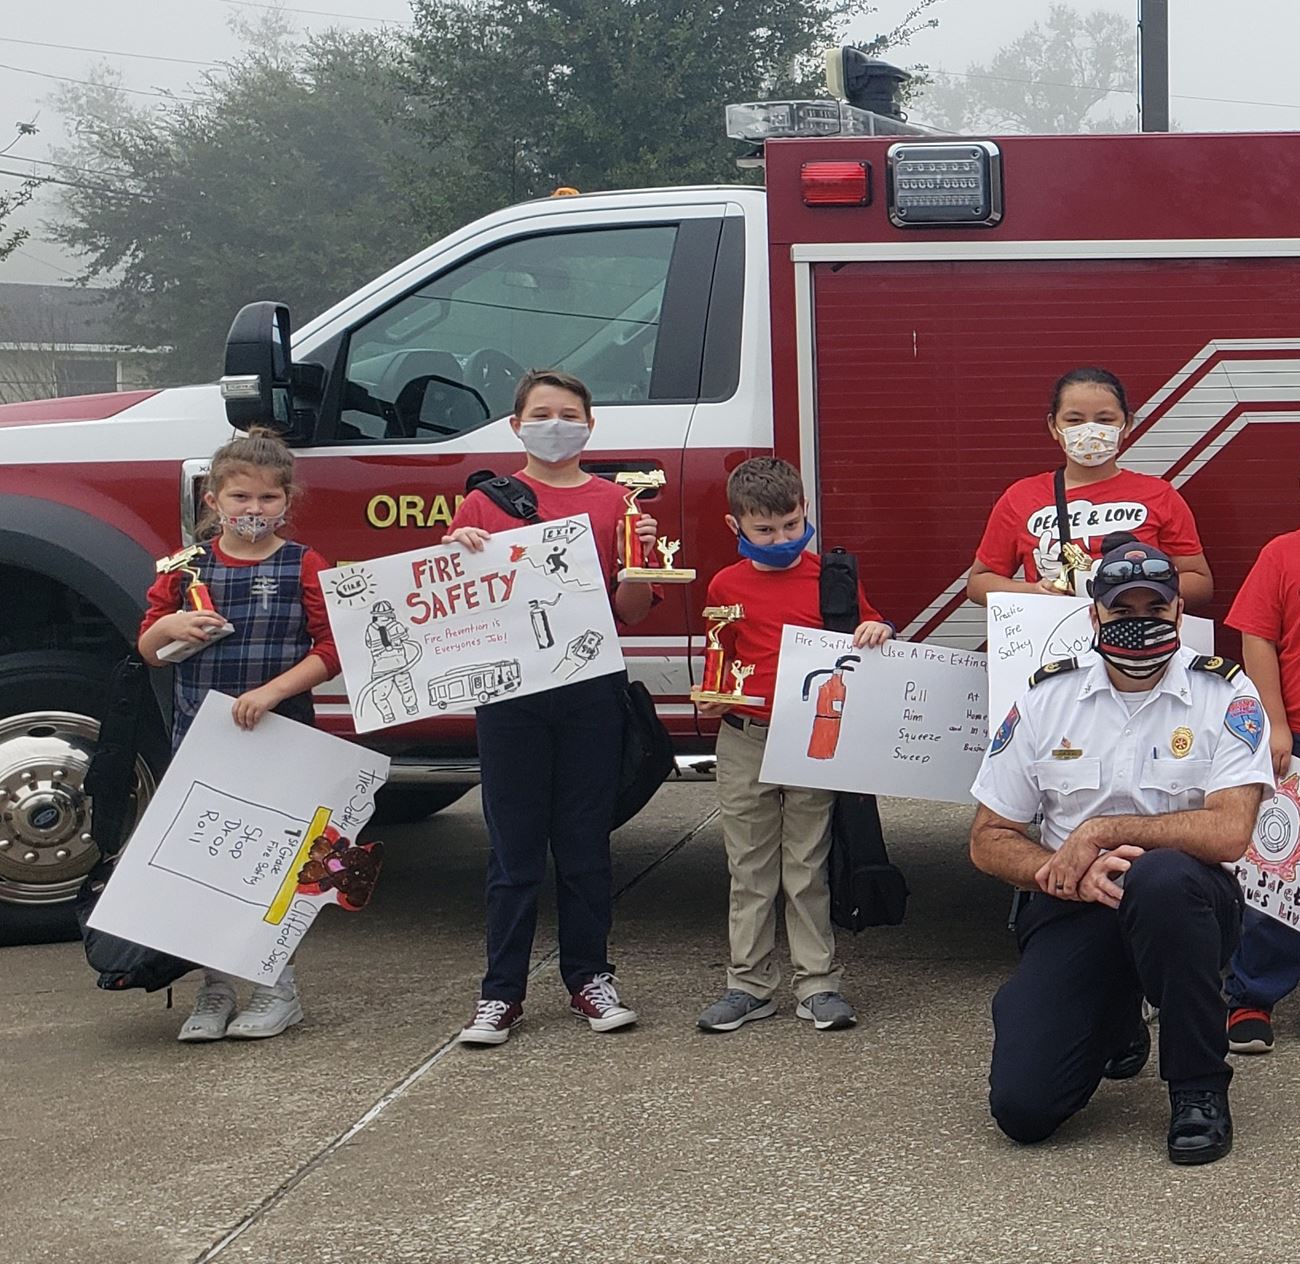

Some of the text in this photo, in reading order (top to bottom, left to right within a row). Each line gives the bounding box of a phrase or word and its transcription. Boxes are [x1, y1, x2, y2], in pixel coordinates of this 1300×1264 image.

[1033, 509, 1143, 533] PEAE & LOVE
[546, 527, 577, 539] EXIT
[406, 569, 517, 625] SAFETY
[424, 618, 501, 645] Fire Prevention is
[1005, 624, 1022, 638] Fire
[795, 632, 813, 647] Fire
[881, 643, 905, 658] Use
[911, 648, 918, 659] A
[924, 649, 945, 663] Fire
[904, 681, 927, 702] Pull
[967, 692, 980, 702] At
[903, 709, 923, 721] Aim
[899, 728, 942, 744] Squeeze
[893, 747, 930, 763] Sweep
[188, 810, 220, 843] Roll
[209, 819, 242, 856] Drop
[229, 825, 263, 859] Stop
[263, 840, 279, 858] Fire
[271, 847, 294, 874] Grade
